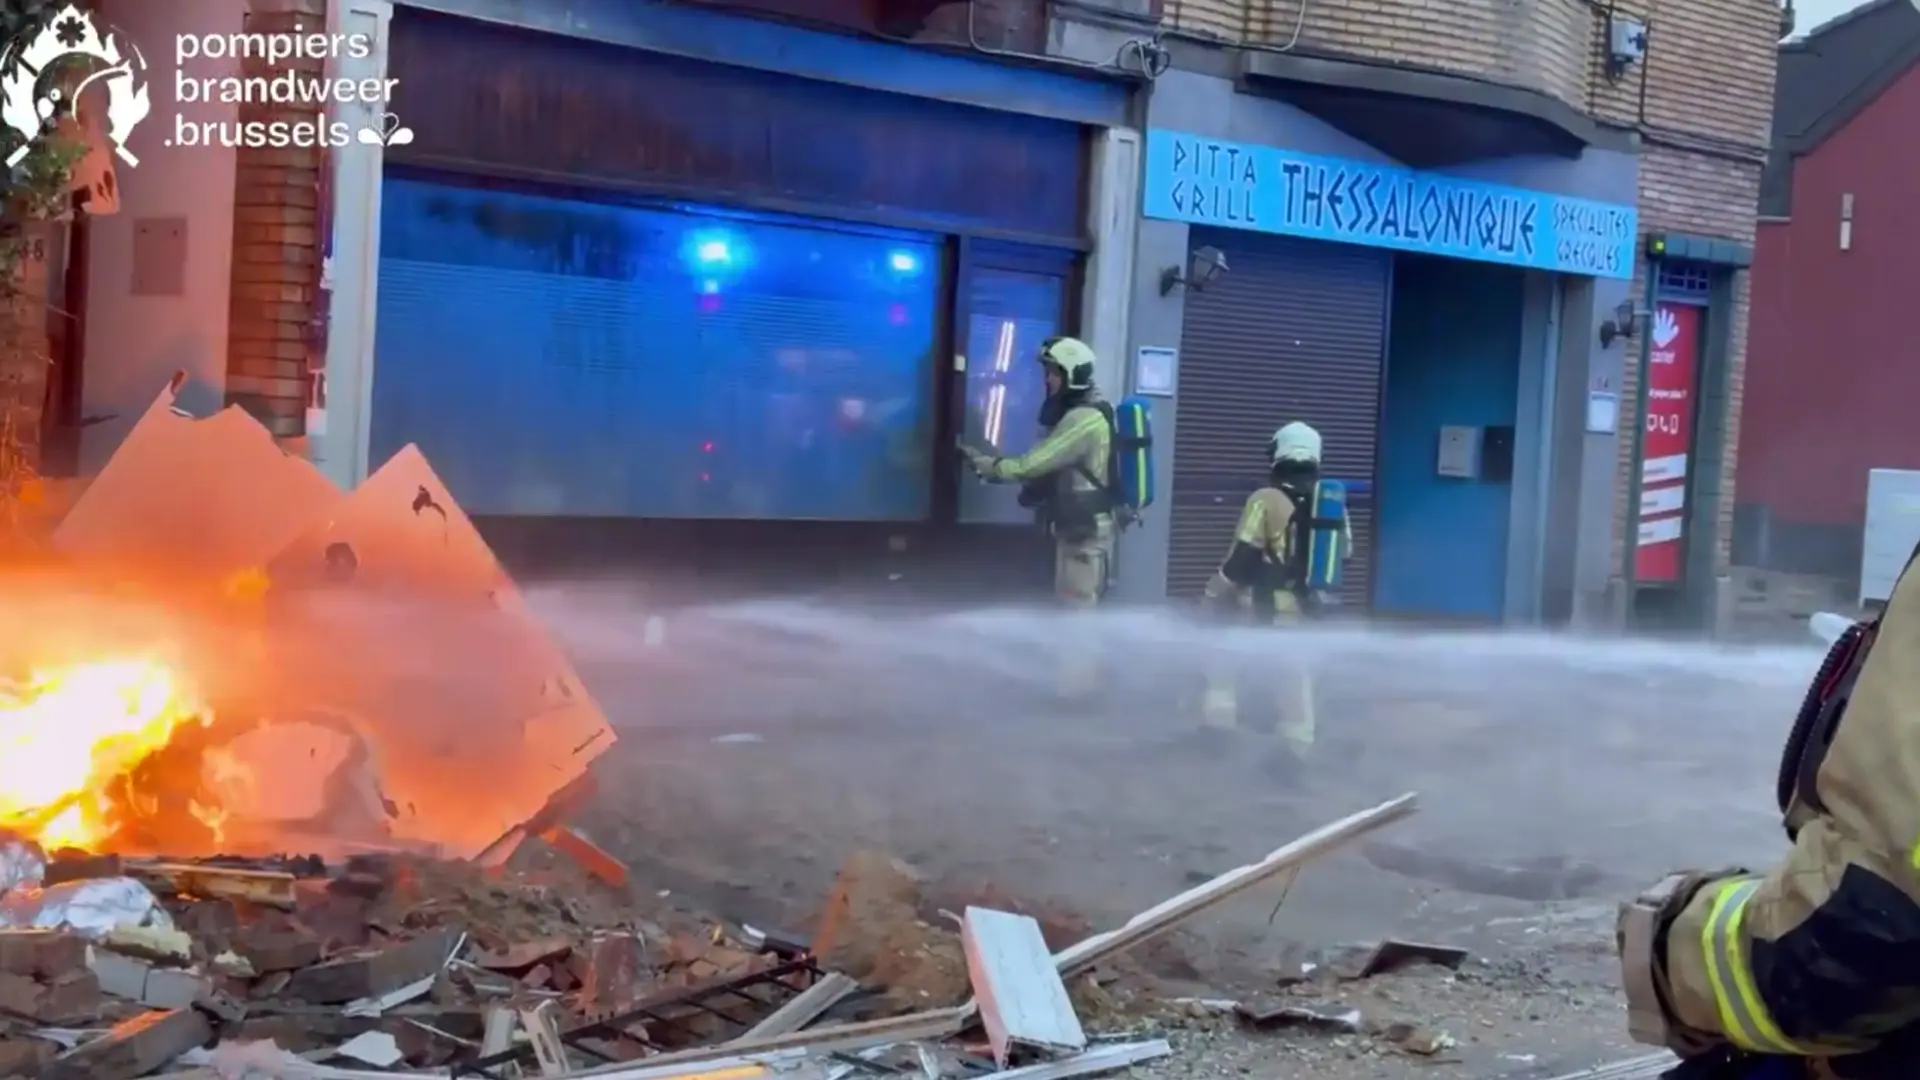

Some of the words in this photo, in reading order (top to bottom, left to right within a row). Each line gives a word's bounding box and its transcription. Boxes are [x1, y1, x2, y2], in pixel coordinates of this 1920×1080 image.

[1174, 140, 1256, 184] PITTA
[1172, 180, 1256, 222] GRILL
[1283, 163, 1536, 254] THESSALONIQUE
